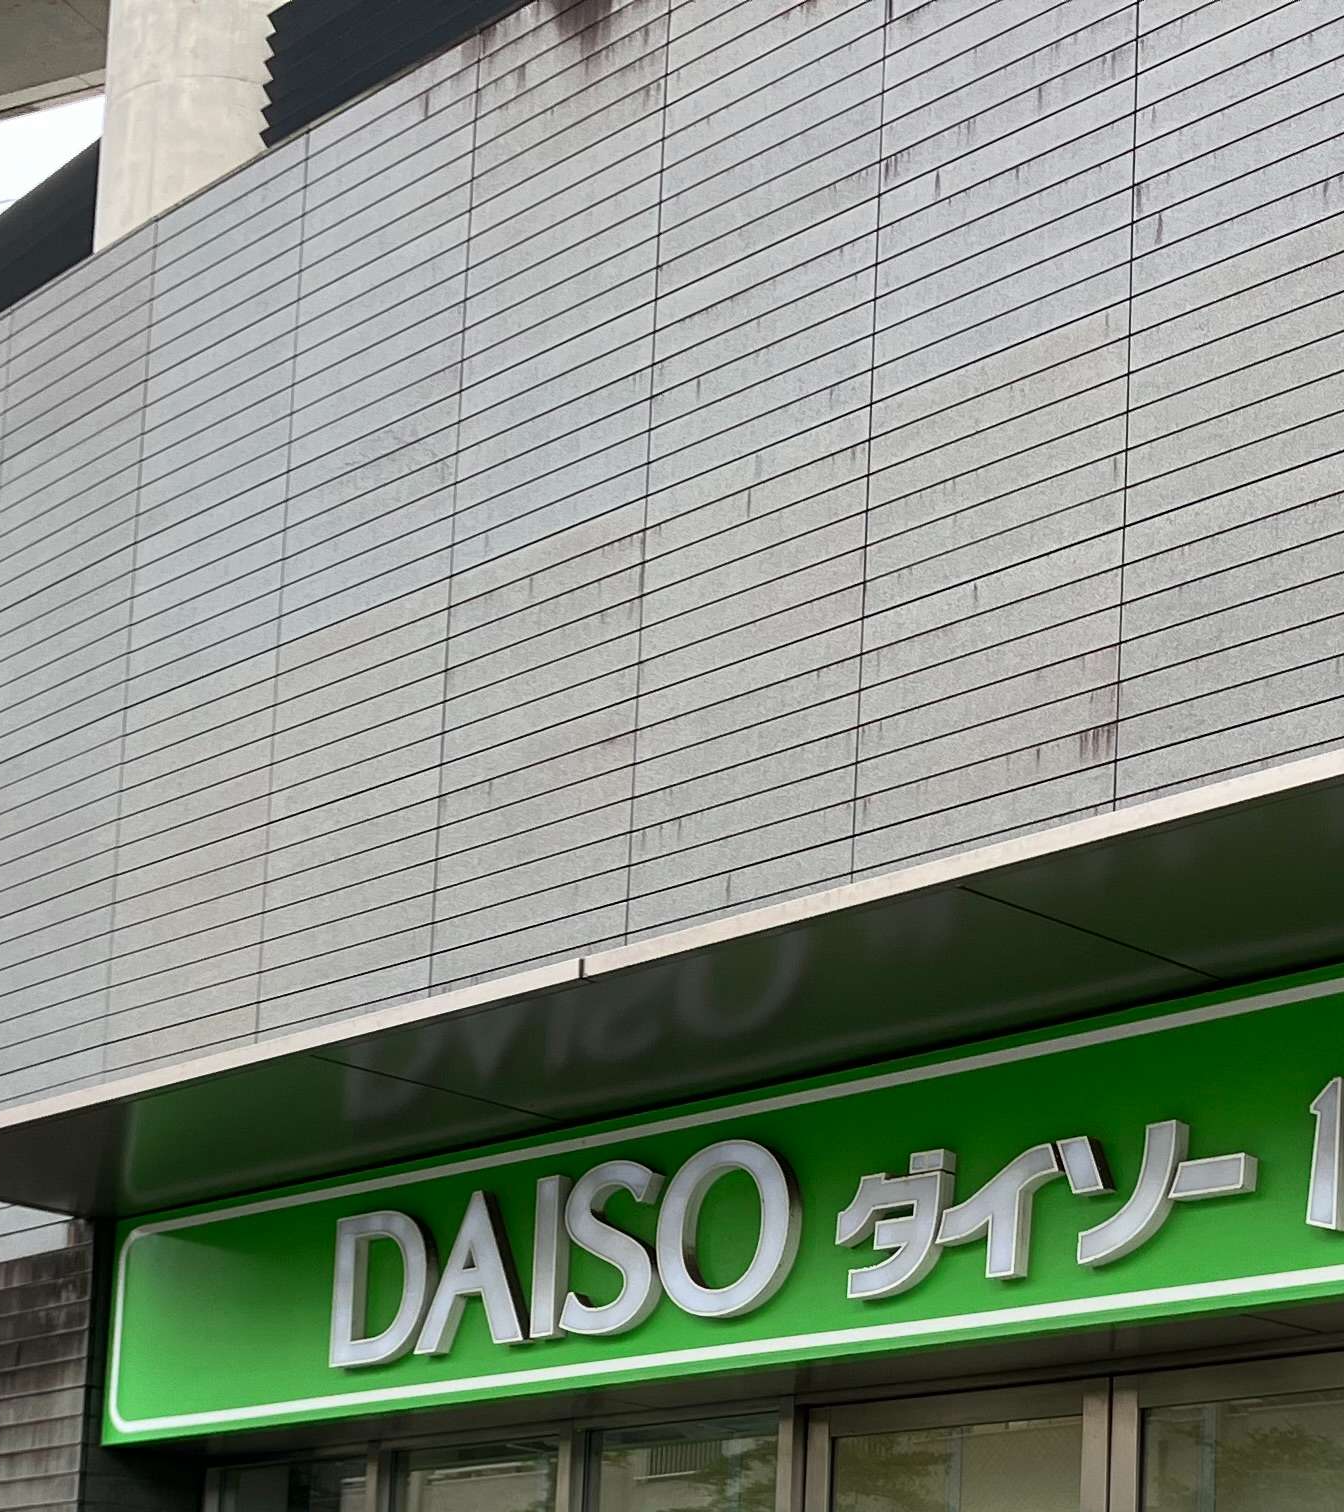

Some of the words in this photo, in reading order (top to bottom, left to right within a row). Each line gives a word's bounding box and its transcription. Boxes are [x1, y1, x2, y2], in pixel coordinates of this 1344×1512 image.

[328, 1139, 803, 1369] DAISO
[835, 1119, 1258, 1300] ダイソー
